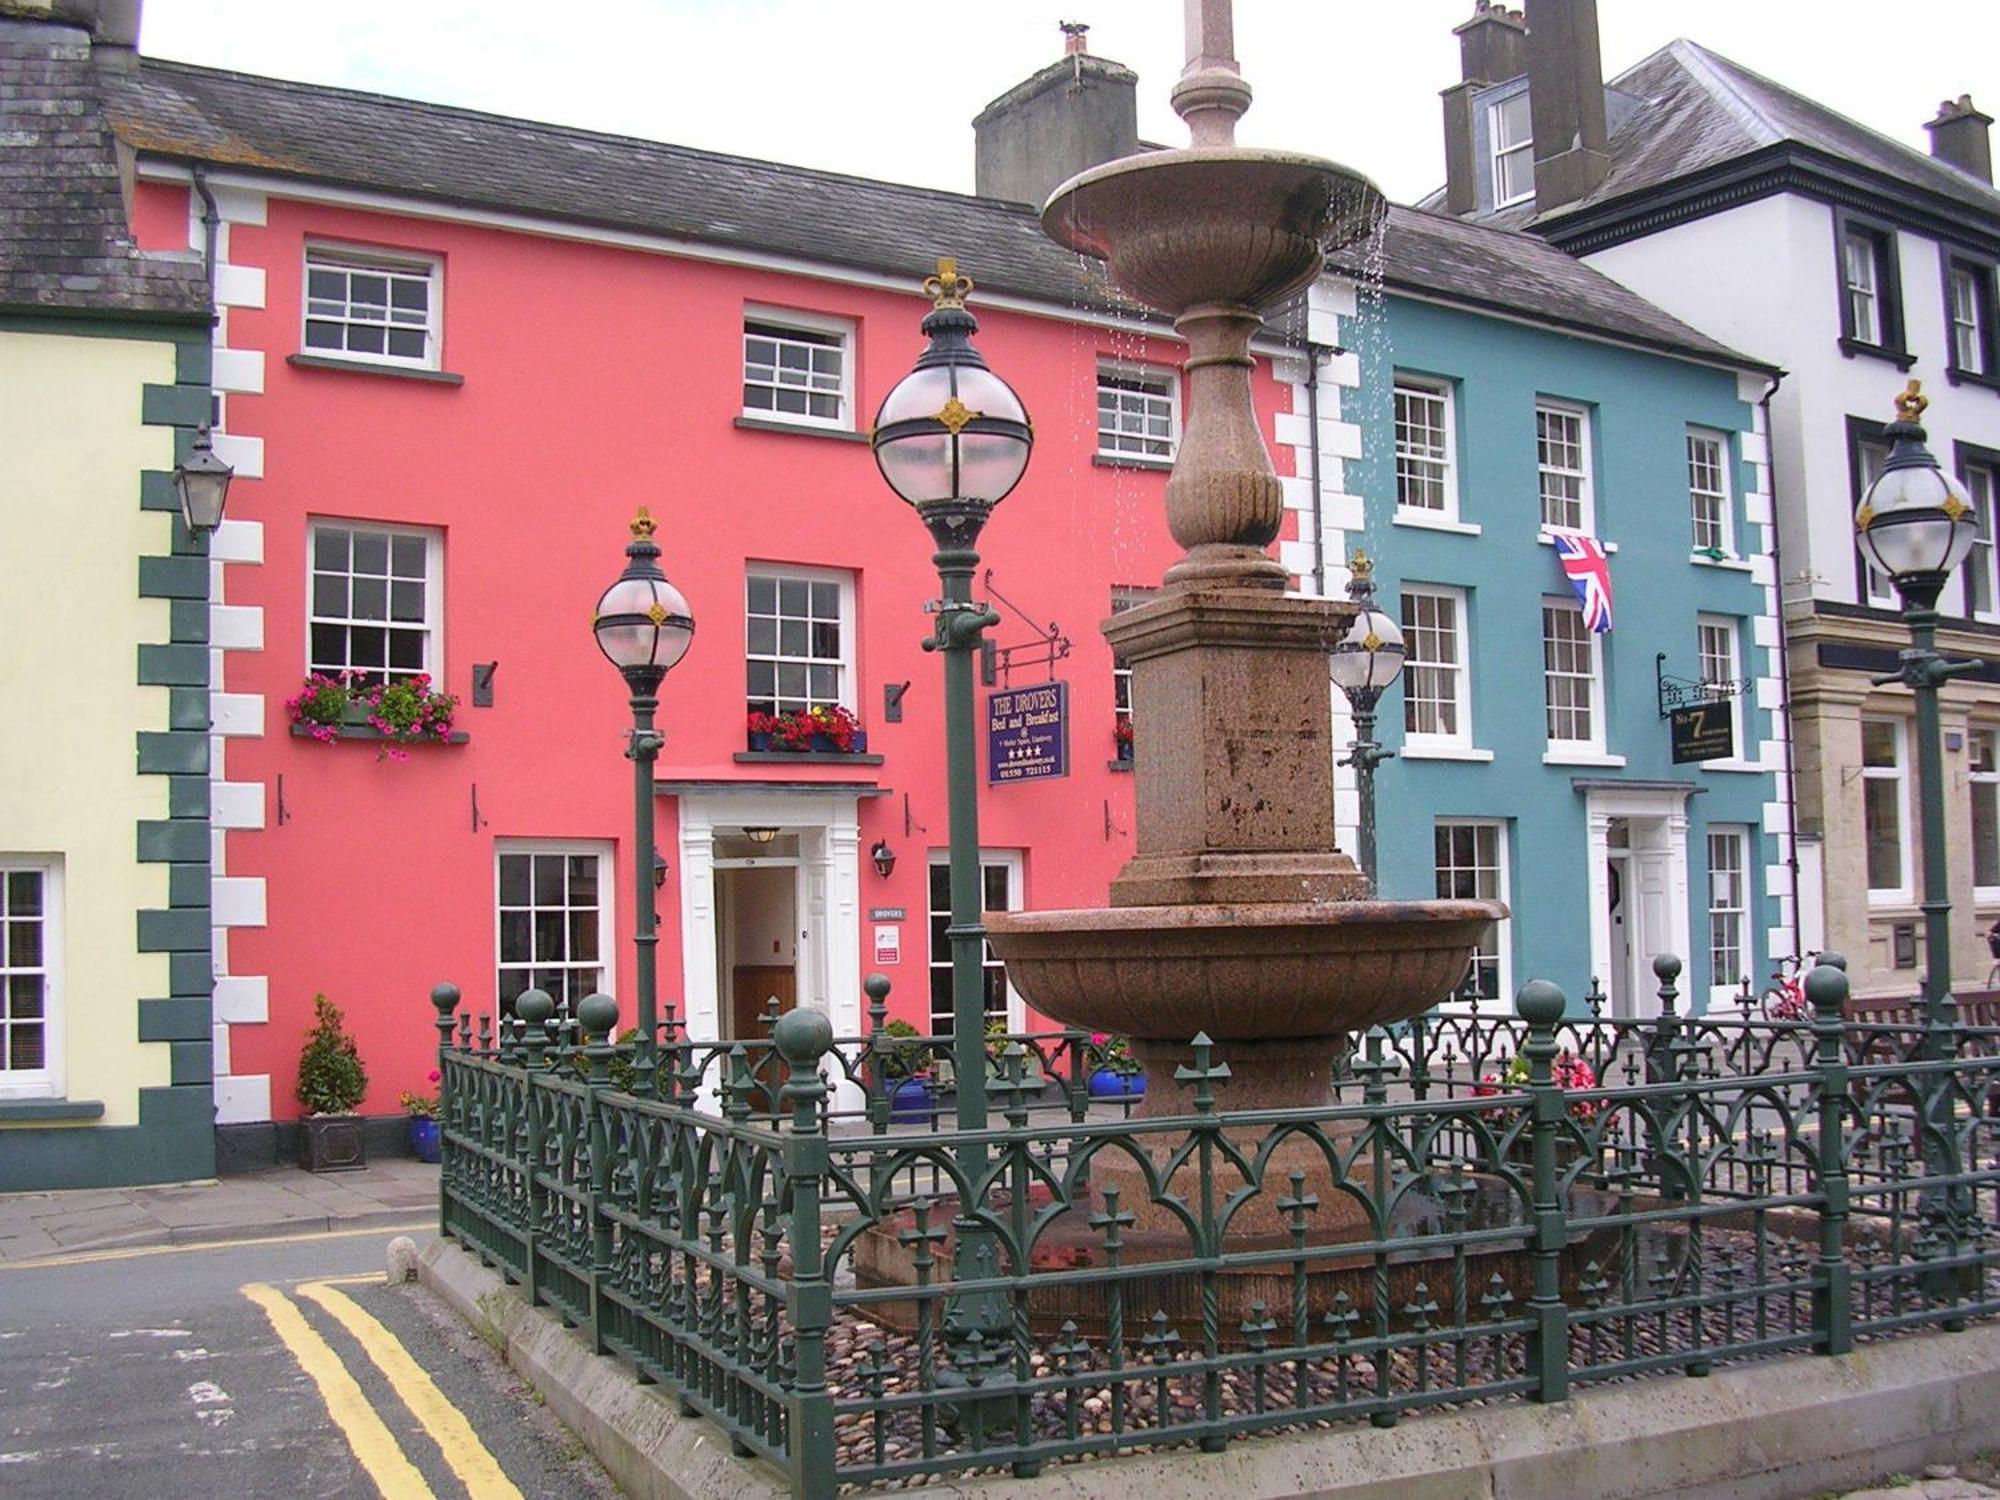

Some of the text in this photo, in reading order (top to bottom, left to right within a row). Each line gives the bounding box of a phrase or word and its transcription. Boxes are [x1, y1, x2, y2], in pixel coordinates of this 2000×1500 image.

[993, 688, 1057, 716] THE DROVERS
[991, 710, 1059, 732] Bed and Breakfast
[1689, 711, 1705, 738] 7
[1025, 765, 1052, 776] 721115
